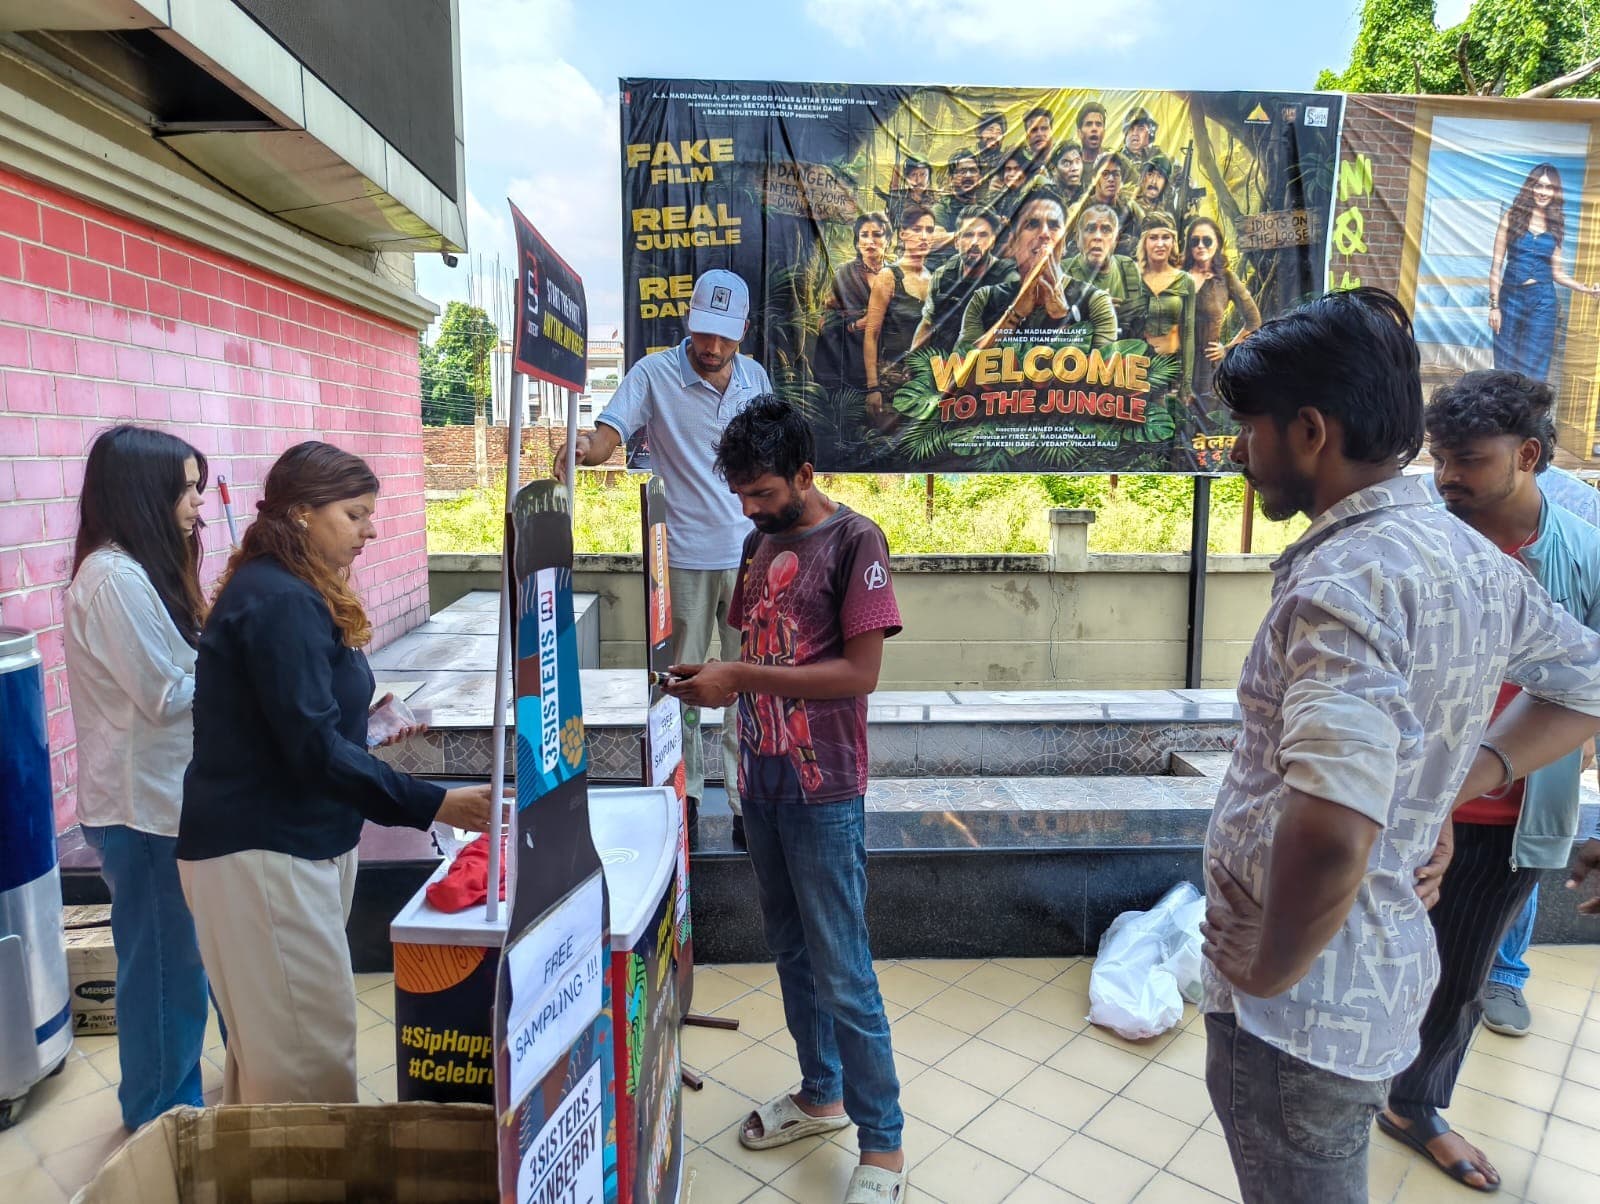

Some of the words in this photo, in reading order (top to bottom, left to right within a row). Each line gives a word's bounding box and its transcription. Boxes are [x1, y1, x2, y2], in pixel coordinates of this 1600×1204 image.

[707, 109, 727, 117] BASE
[802, 97, 819, 105] STAR
[626, 138, 735, 168] FAKE
[651, 166, 714, 185] FILM
[632, 203, 742, 232] REAL
[1250, 216, 1288, 232] IDIOTS
[1292, 215, 1308, 226] ON
[636, 229, 742, 251] JUNGLE
[1248, 232, 1270, 246] THE
[1275, 228, 1309, 244] LOOSE
[638, 274, 693, 300] RE
[640, 302, 691, 319] DAN
[930, 346, 1151, 393] WELCOME
[938, 396, 976, 422] TO
[981, 390, 1037, 414] THE
[1039, 389, 1147, 423] JUNGLE
[542, 629, 557, 764] 3SISTERS
[544, 934, 574, 984] FREE
[515, 973, 583, 1062] SAMPLING
[587, 954, 598, 983] !!!
[401, 1024, 492, 1058] #SipHapp
